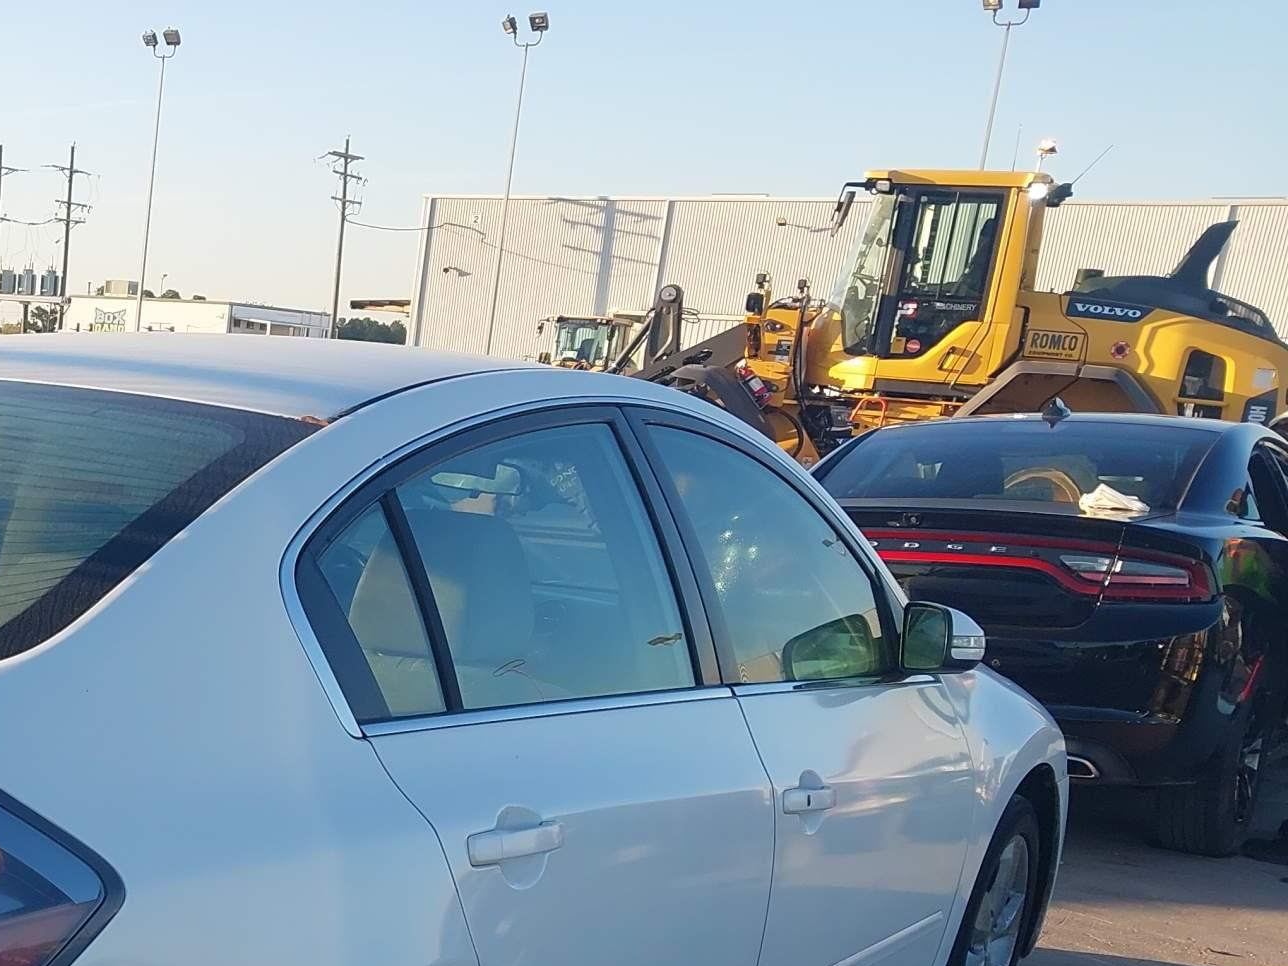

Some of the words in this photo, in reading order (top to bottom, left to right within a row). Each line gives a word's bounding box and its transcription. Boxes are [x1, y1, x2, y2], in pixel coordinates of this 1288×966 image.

[94, 307, 127, 325] BOX
[1074, 302, 1142, 318] VOLVO
[1030, 332, 1079, 351] ROMCO
